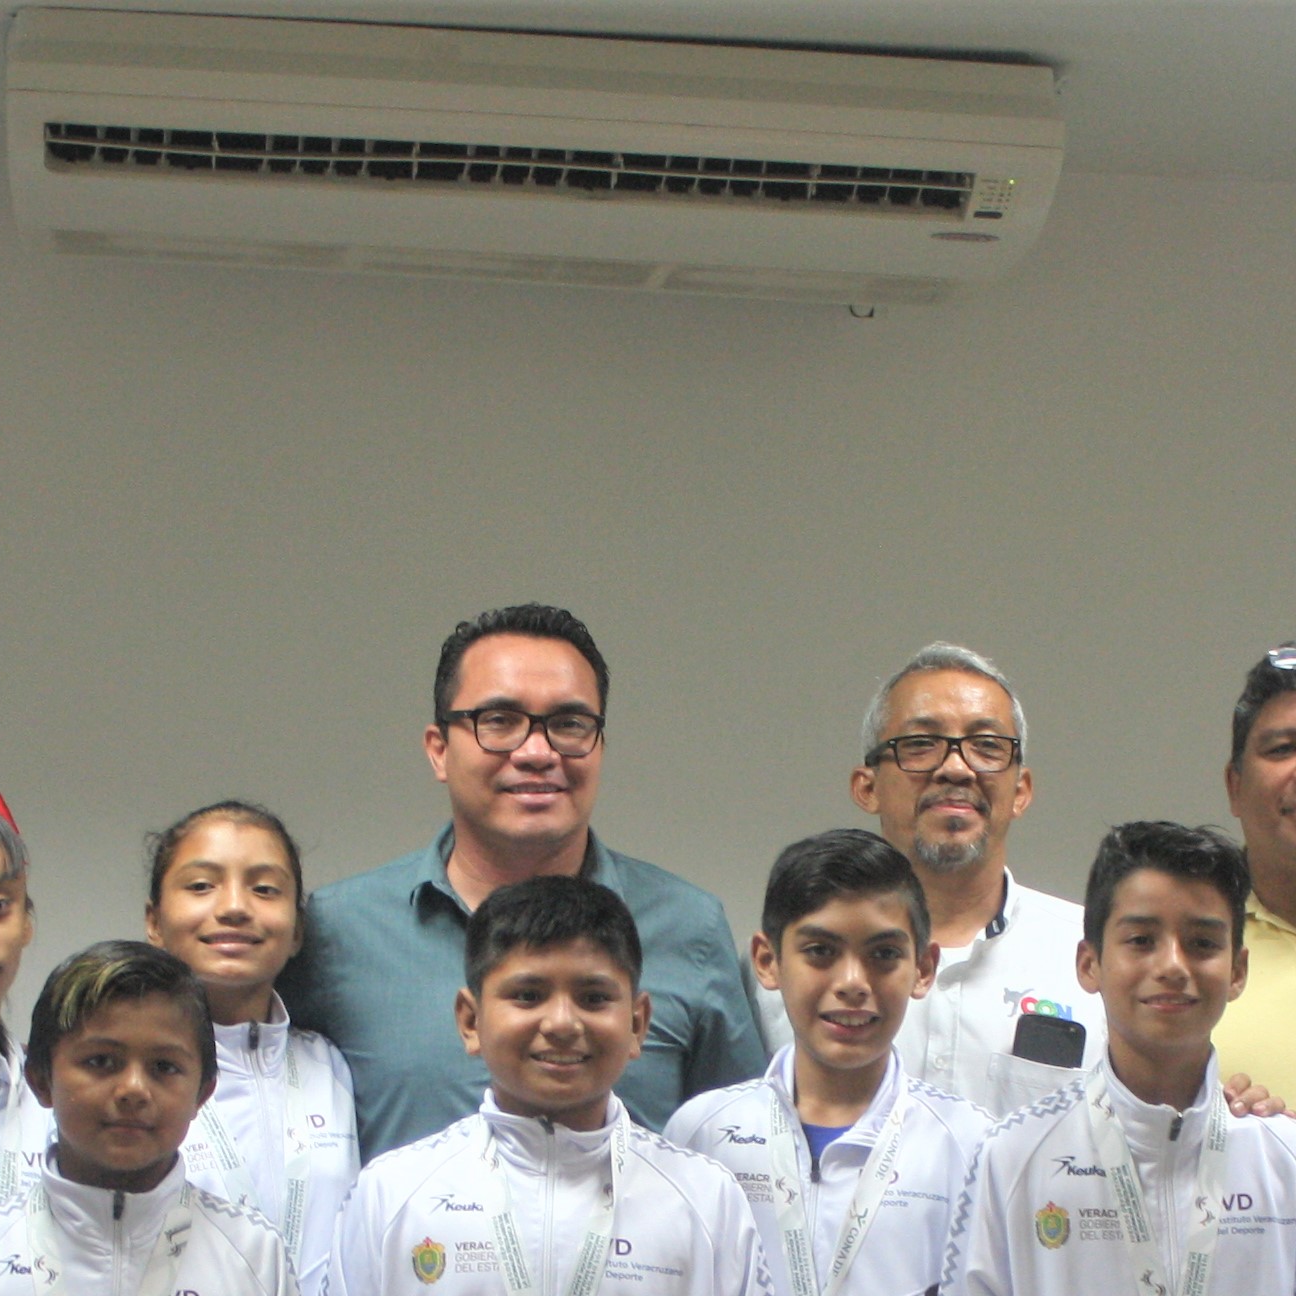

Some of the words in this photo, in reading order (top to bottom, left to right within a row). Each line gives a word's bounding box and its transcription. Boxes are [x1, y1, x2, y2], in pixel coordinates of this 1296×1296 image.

[876, 1133, 900, 1180] CONADE
[1067, 1165, 1107, 1177] Keuka
[445, 1202, 484, 1212] Keuka
[1231, 1227, 1265, 1235] Deporte
[606, 1271, 644, 1281] Deporte
